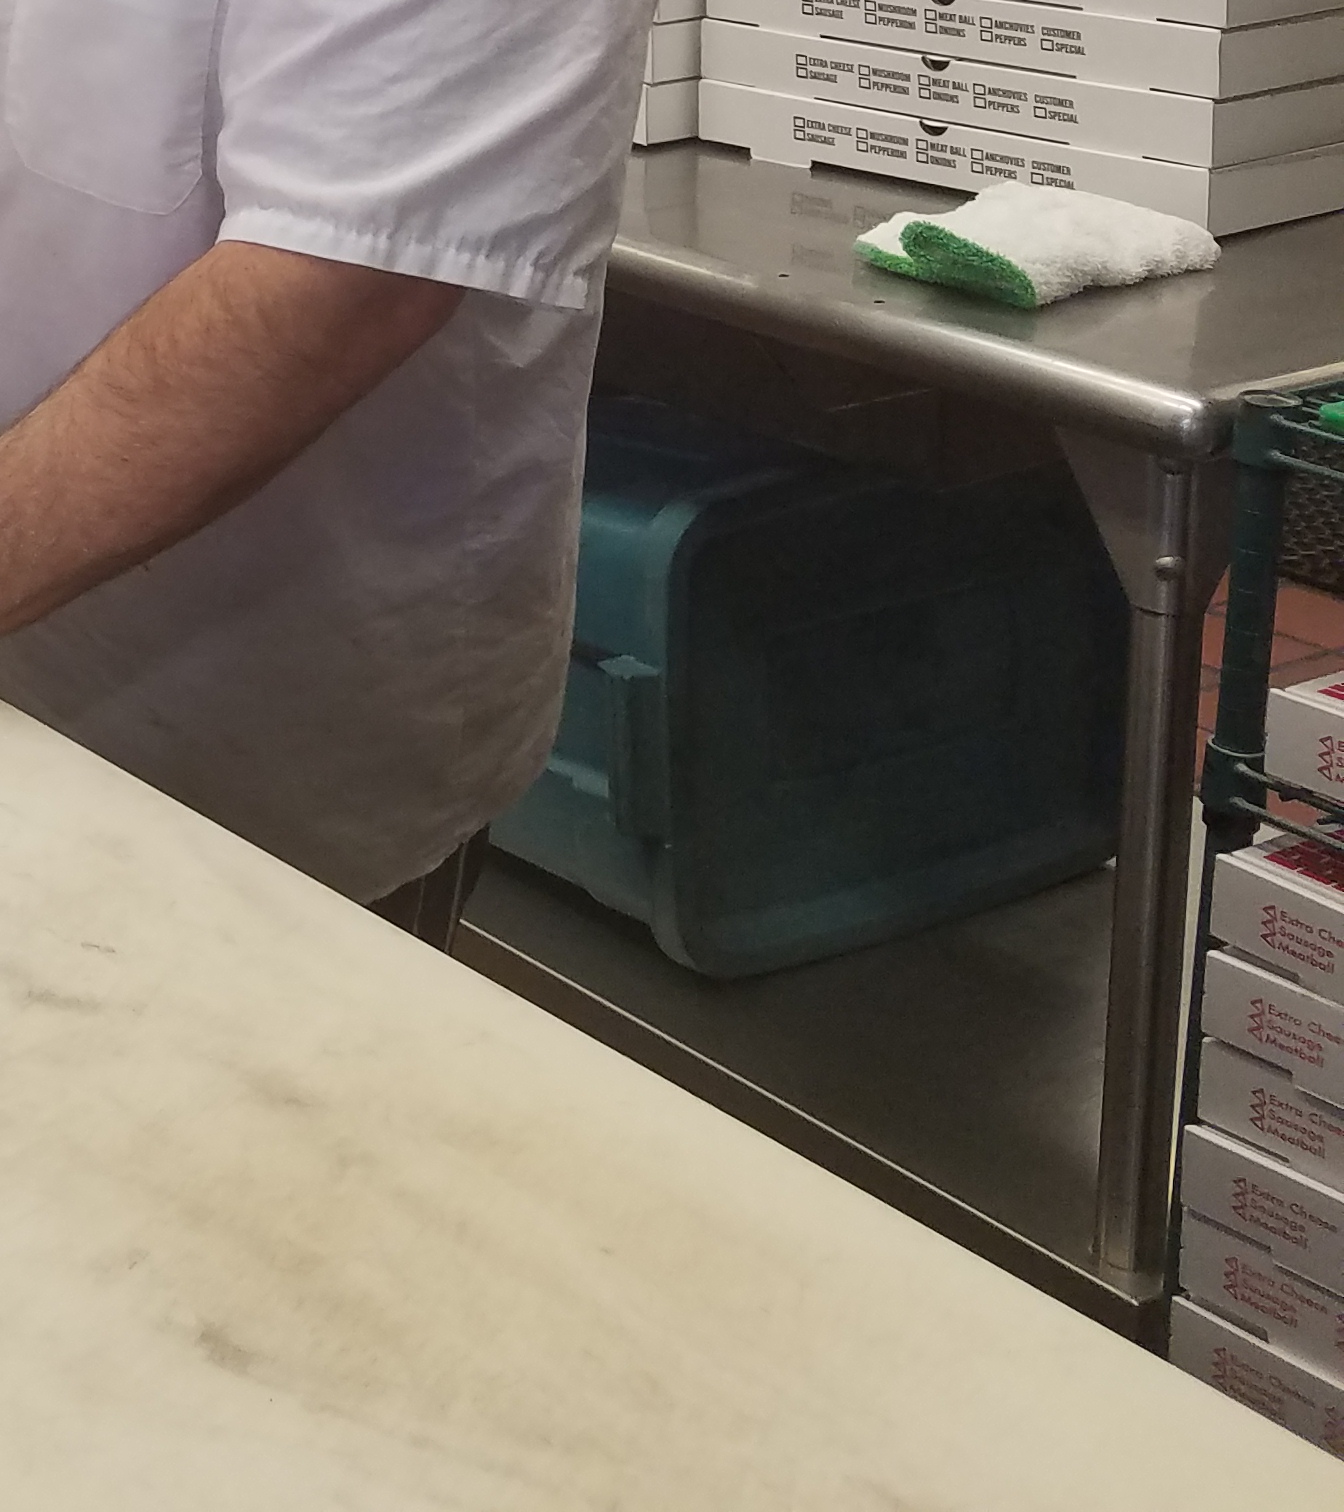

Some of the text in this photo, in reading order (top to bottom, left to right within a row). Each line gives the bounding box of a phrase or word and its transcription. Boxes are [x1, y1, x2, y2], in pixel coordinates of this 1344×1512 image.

[952, 81, 969, 92] BALL
[1034, 95, 1074, 109] CUSTOMER
[988, 101, 1020, 114] PEPPERS
[1048, 111, 1078, 124] SPECIAL
[1280, 910, 1313, 934] Extra
[1280, 927, 1335, 959] Sausage
[1278, 942, 1335, 974] Meatball
